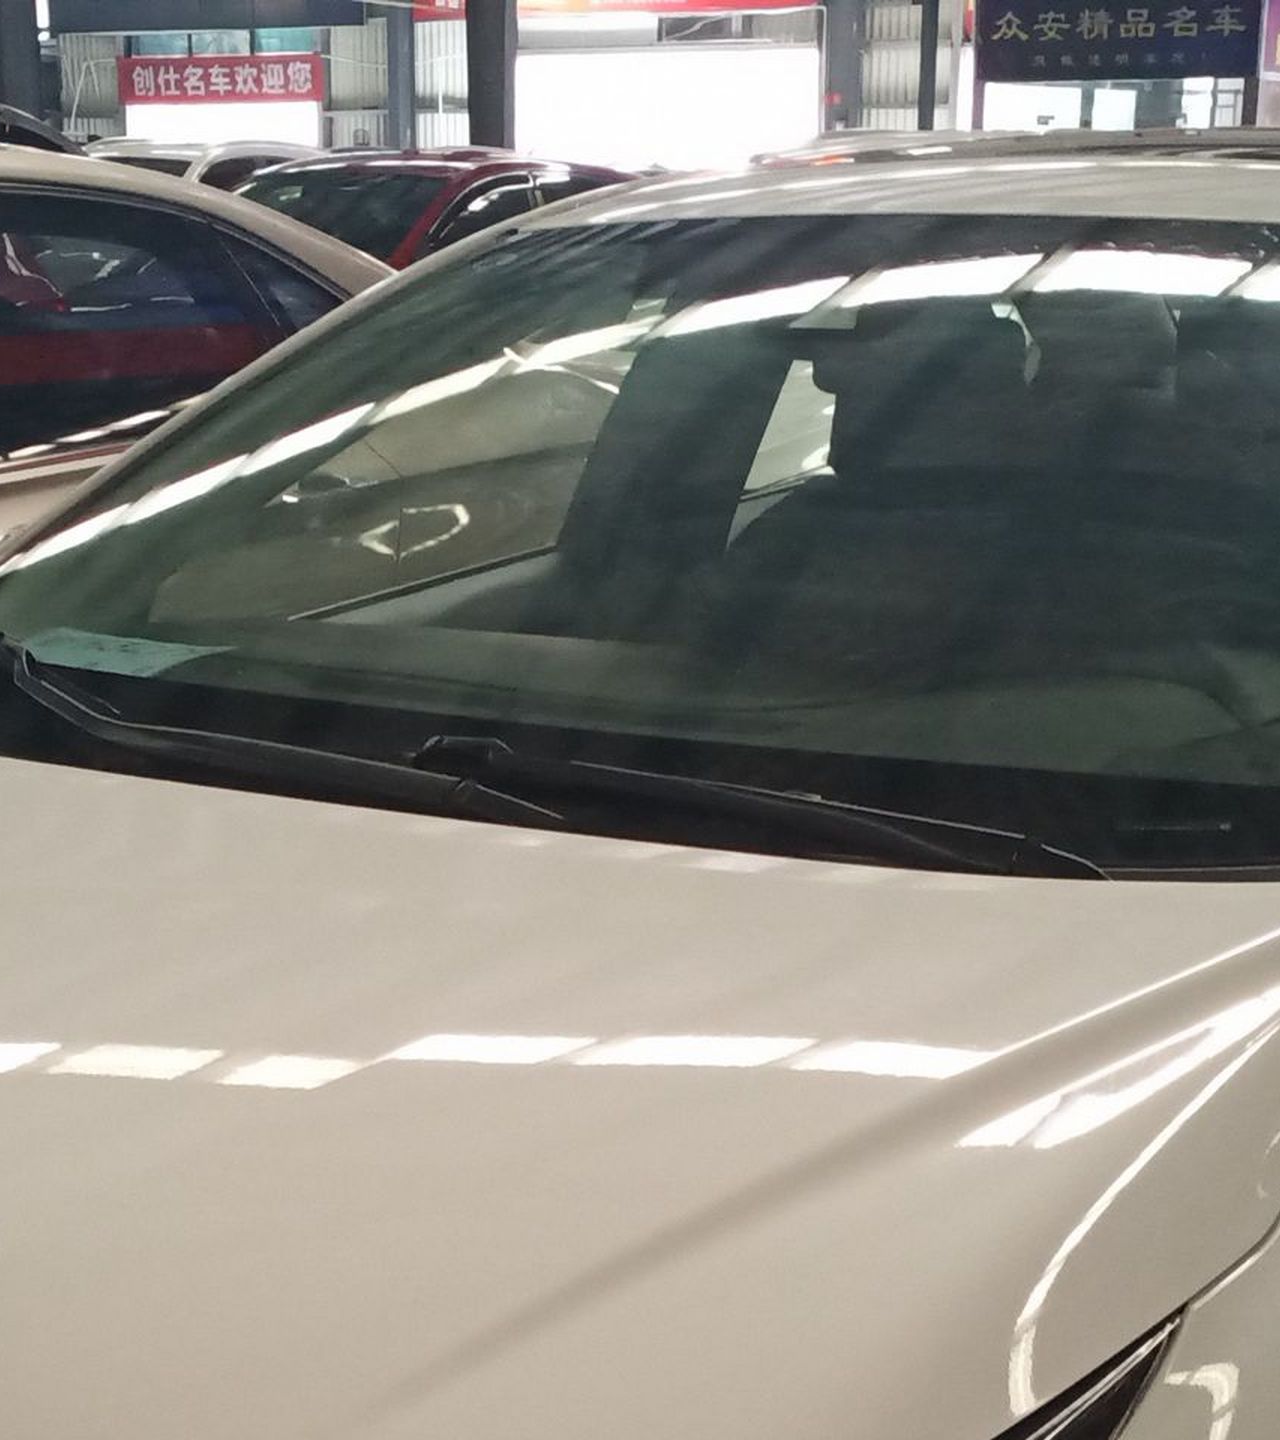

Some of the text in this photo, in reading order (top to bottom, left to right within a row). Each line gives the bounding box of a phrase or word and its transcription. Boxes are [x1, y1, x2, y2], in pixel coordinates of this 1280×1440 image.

[991, 6, 1246, 41] 众安精品名车
[132, 61, 312, 96] 创仕名车欢迎您
